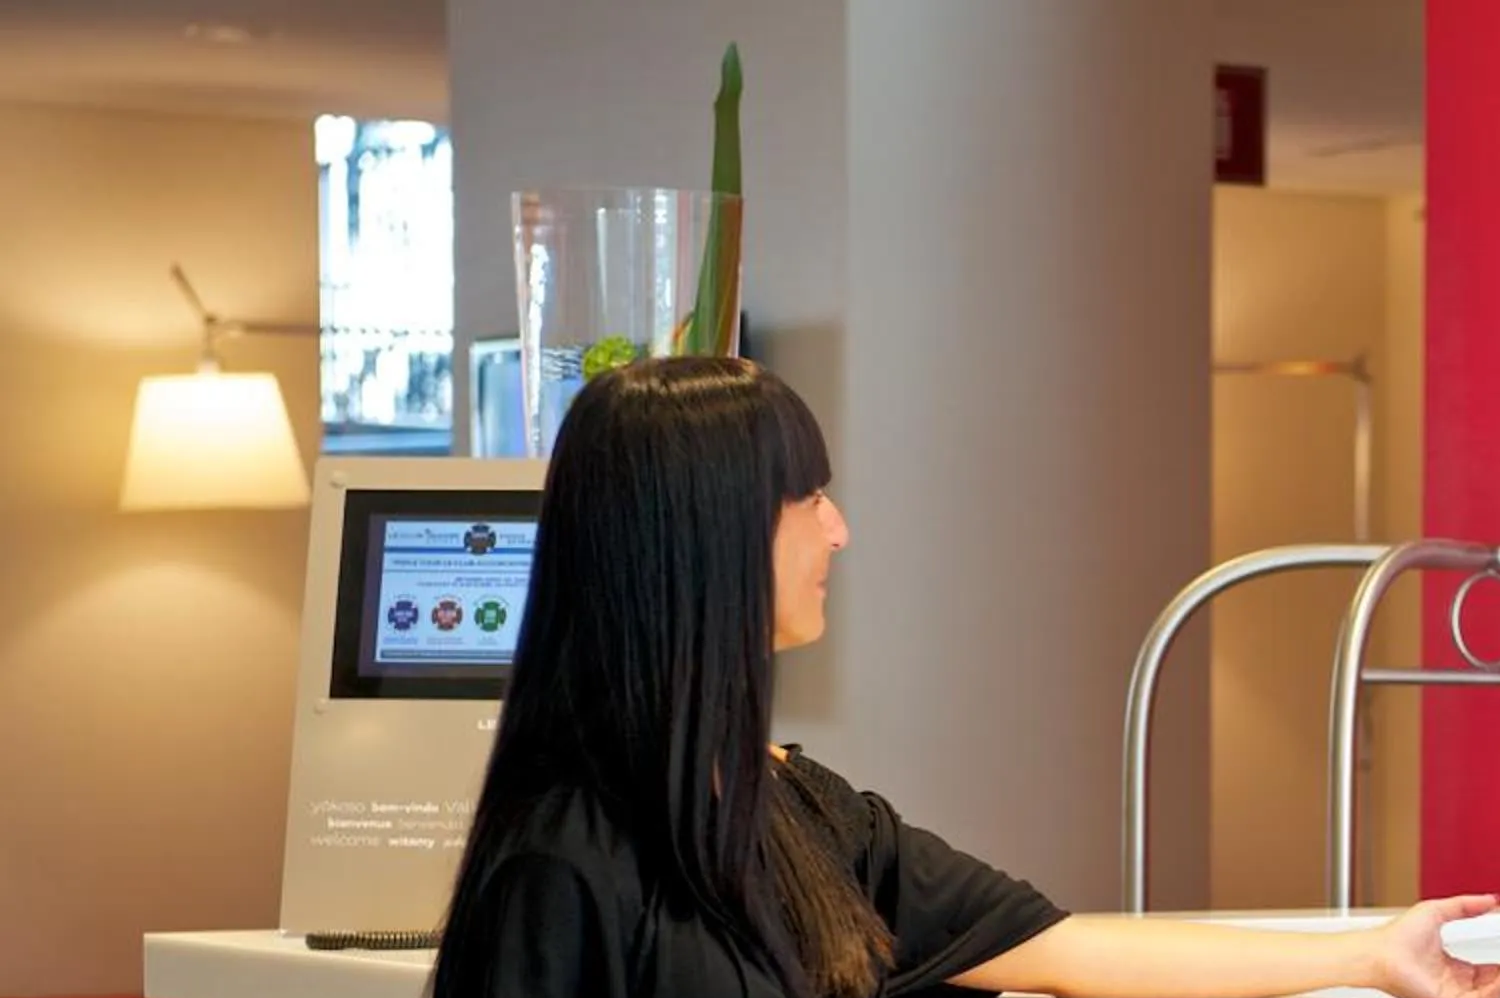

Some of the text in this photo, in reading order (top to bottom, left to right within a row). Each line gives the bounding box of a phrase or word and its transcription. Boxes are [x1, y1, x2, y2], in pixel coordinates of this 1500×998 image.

[371, 801, 440, 814] bem-vindo
[327, 817, 393, 829] bienvenue
[388, 836, 436, 849] witamy
